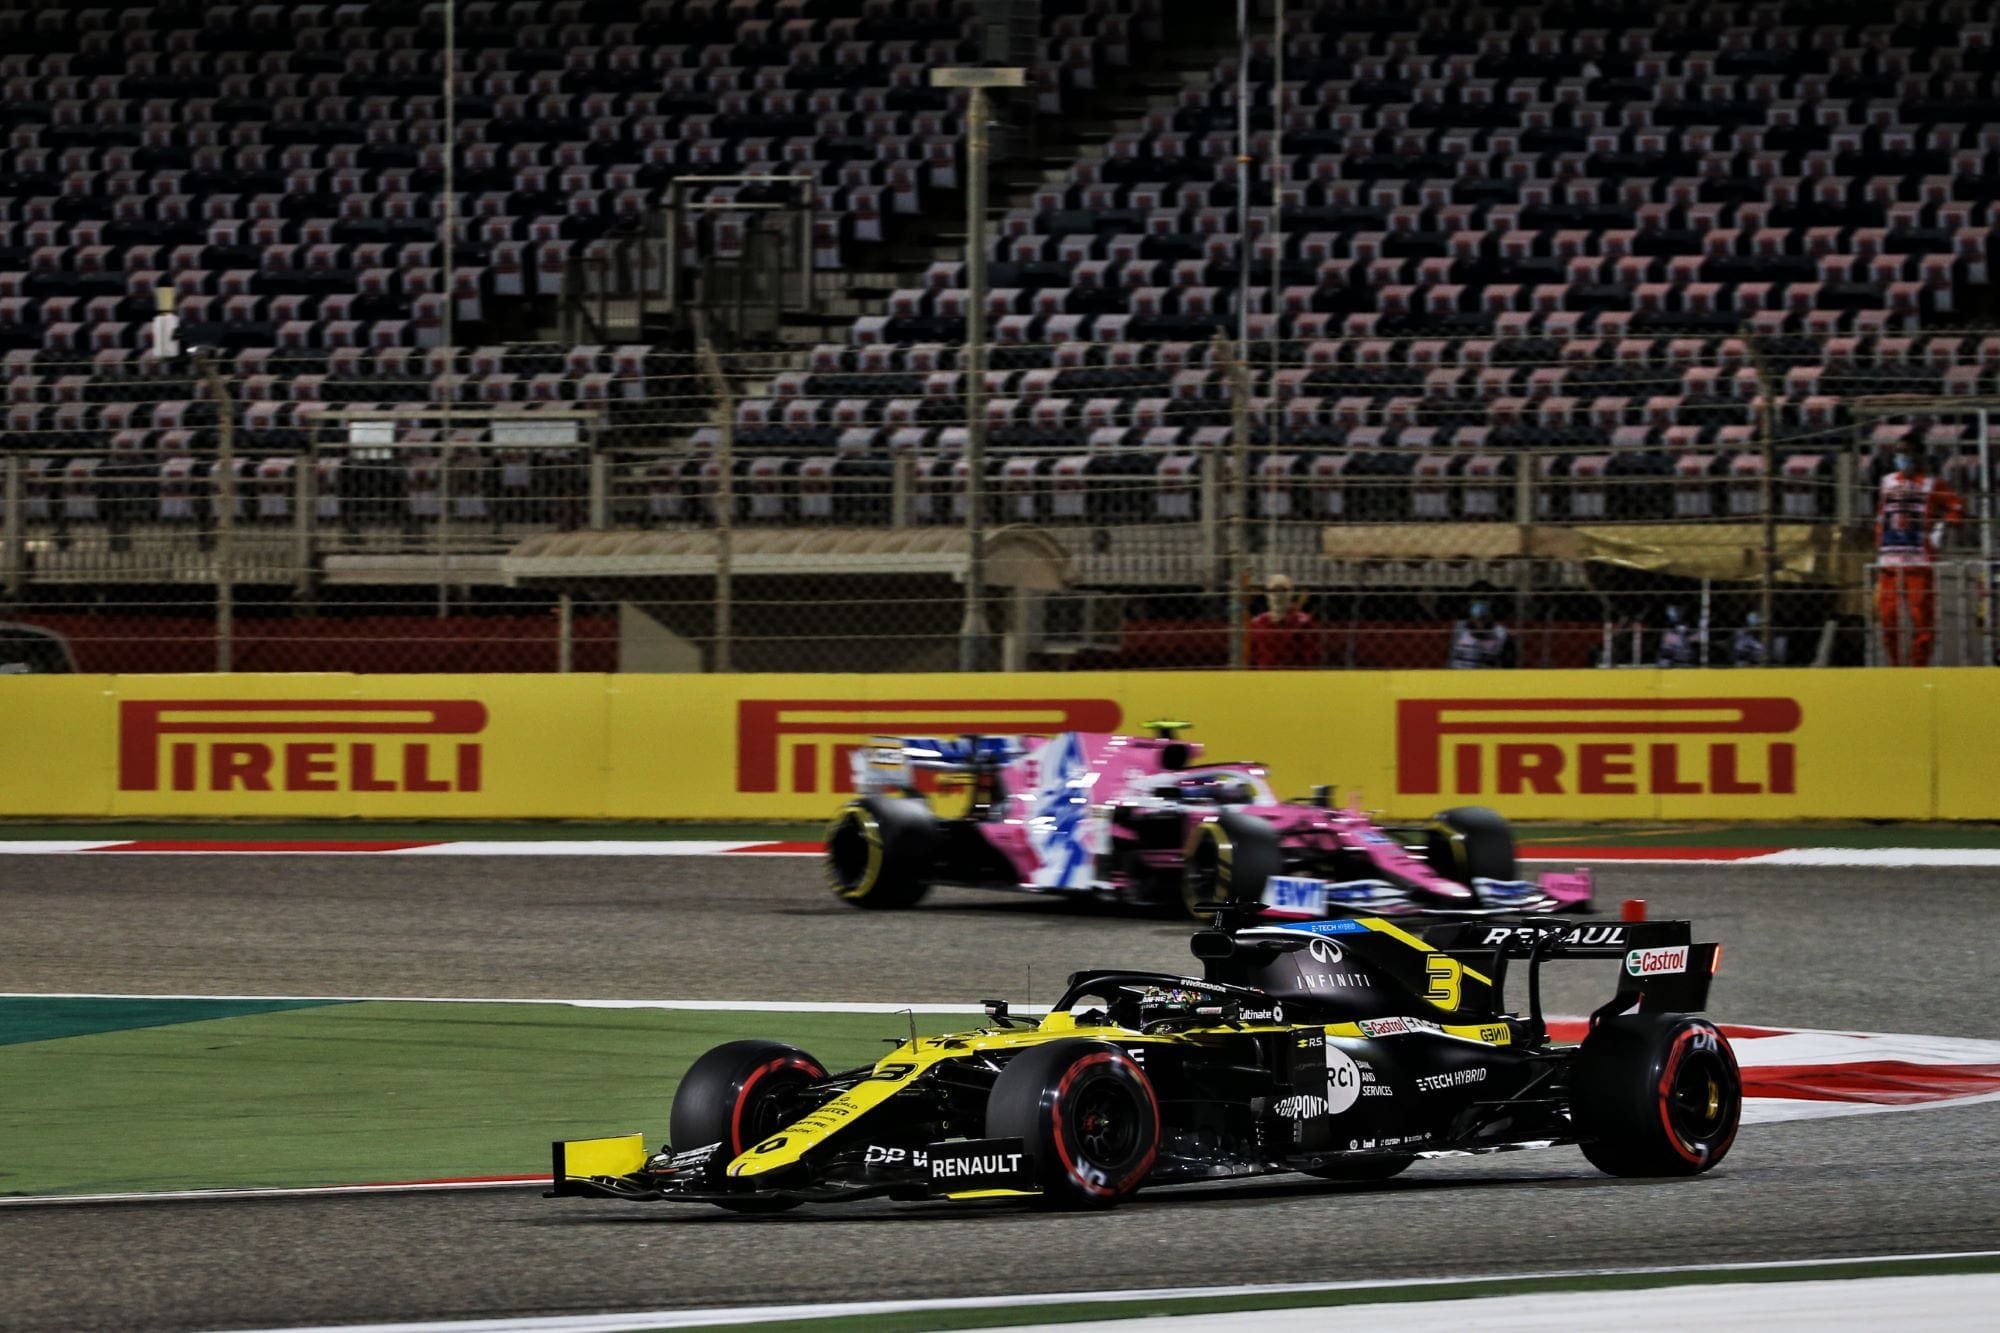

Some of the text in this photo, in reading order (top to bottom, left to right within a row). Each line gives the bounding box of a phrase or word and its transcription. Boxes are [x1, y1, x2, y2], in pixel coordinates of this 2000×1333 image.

[119, 700, 487, 791] PIRELLI
[1397, 697, 1802, 794] PIRELLI
[1311, 924, 1337, 932] E-TECH
[1641, 950, 1684, 972] Castrol
[1296, 973, 1371, 989] INFINITI
[1423, 953, 1463, 1012] 3
[1239, 1009, 1272, 1020] ultimate
[1370, 1018, 1407, 1035] Castrol
[871, 1063, 919, 1082] 3
[1362, 1072, 1376, 1082] AND
[1416, 1067, 1487, 1091] E-TECH HYBRID
[1362, 1085, 1393, 1097] SERVICES
[1280, 1095, 1323, 1119] DUPONT
[932, 1154, 1022, 1178] RENAULT
